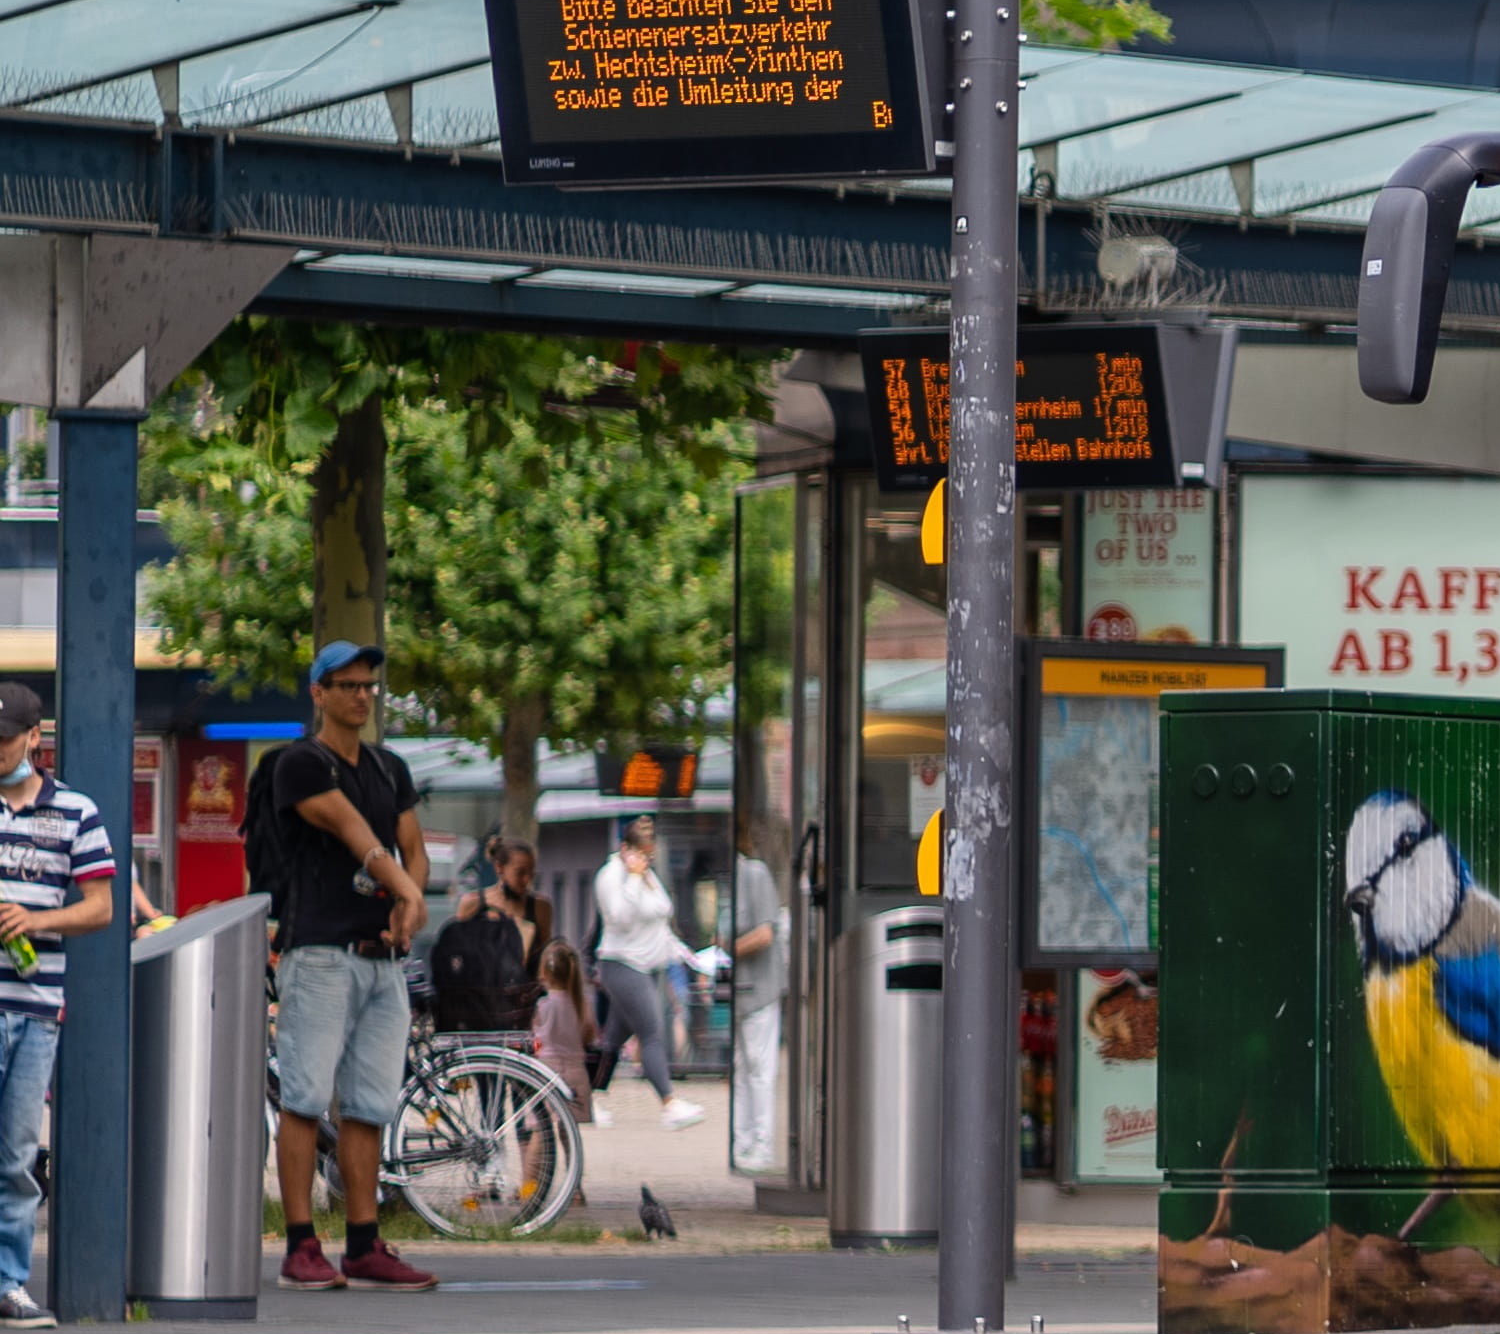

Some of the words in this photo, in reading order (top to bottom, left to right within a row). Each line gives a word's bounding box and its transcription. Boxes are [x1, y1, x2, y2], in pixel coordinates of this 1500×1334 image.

[564, 17, 832, 51] Schienenersatzverkehr
[549, 60, 585, 81] zw.
[554, 82, 622, 109] sowie
[633, 81, 668, 107] die
[679, 77, 793, 106] Umleitung
[804, 74, 843, 101] der
[883, 359, 905, 380] 57
[1096, 352, 1108, 373] 3
[1111, 353, 1142, 373] min
[889, 400, 912, 421] 54
[1093, 395, 1112, 417] 17
[1116, 398, 1148, 416] min
[891, 419, 916, 443] 56
[1076, 437, 1152, 460] Bahnhofs
[1155, 490, 1204, 508] THE
[1116, 513, 1178, 536] TWO
[1096, 539, 1128, 562] OF
[1136, 539, 1168, 562] US
[1330, 629, 1412, 673] AB
[1101, 671, 1149, 684] MAINZER
